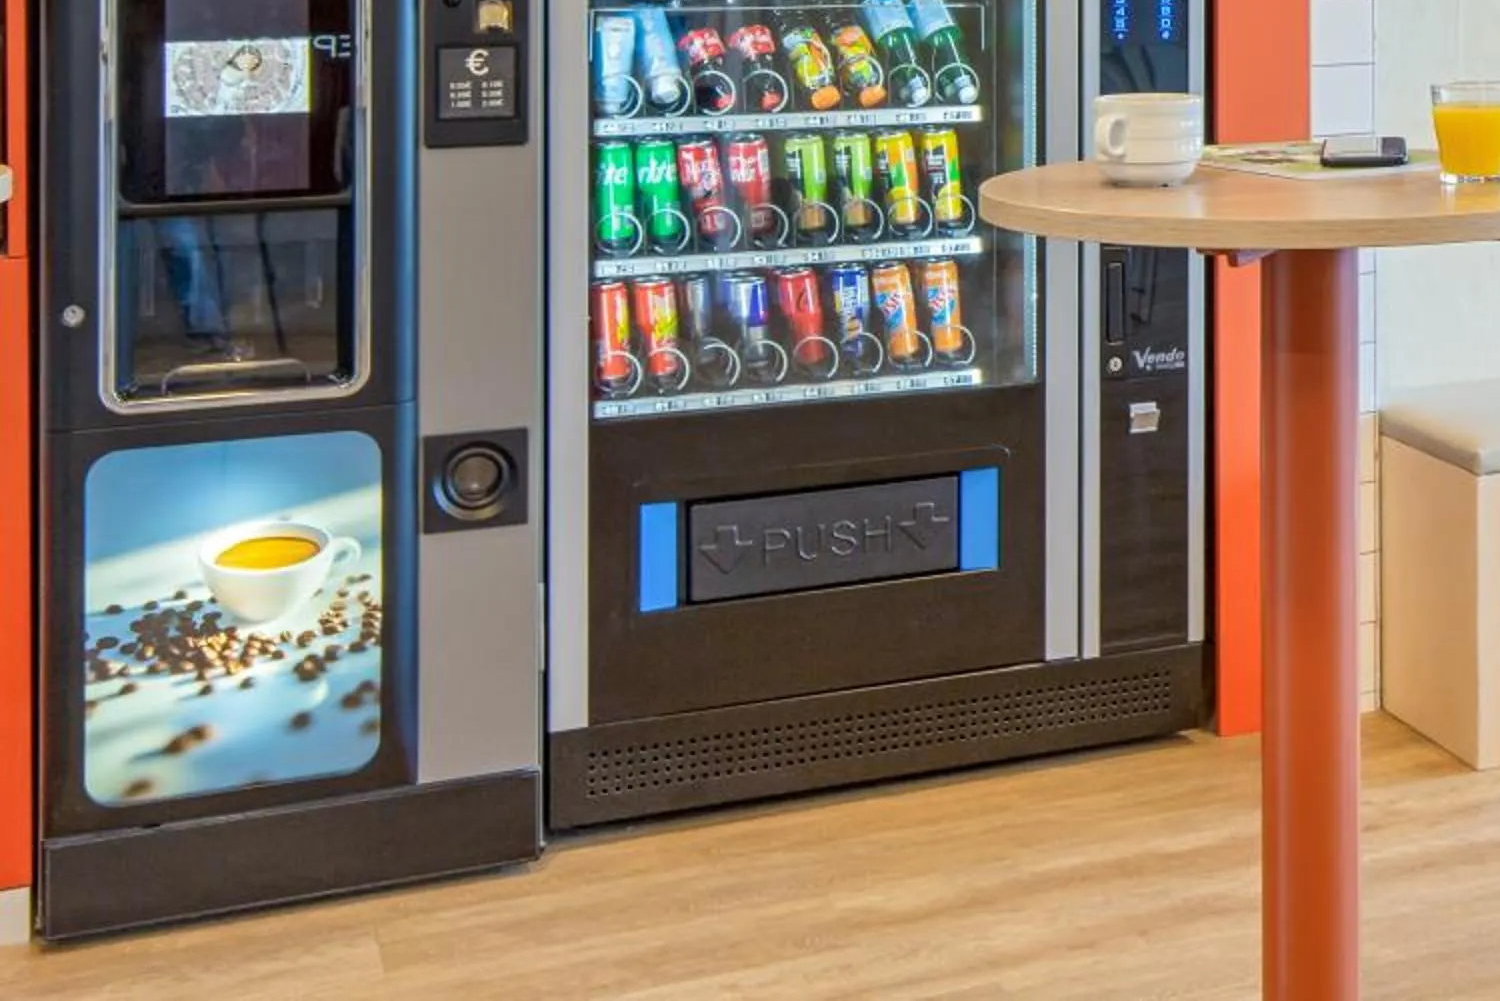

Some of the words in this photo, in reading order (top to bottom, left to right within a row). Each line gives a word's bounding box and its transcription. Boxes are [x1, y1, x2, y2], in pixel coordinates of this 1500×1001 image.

[464, 48, 489, 76] €
[1132, 347, 1185, 370] Vendo
[763, 515, 892, 566] PUSH
